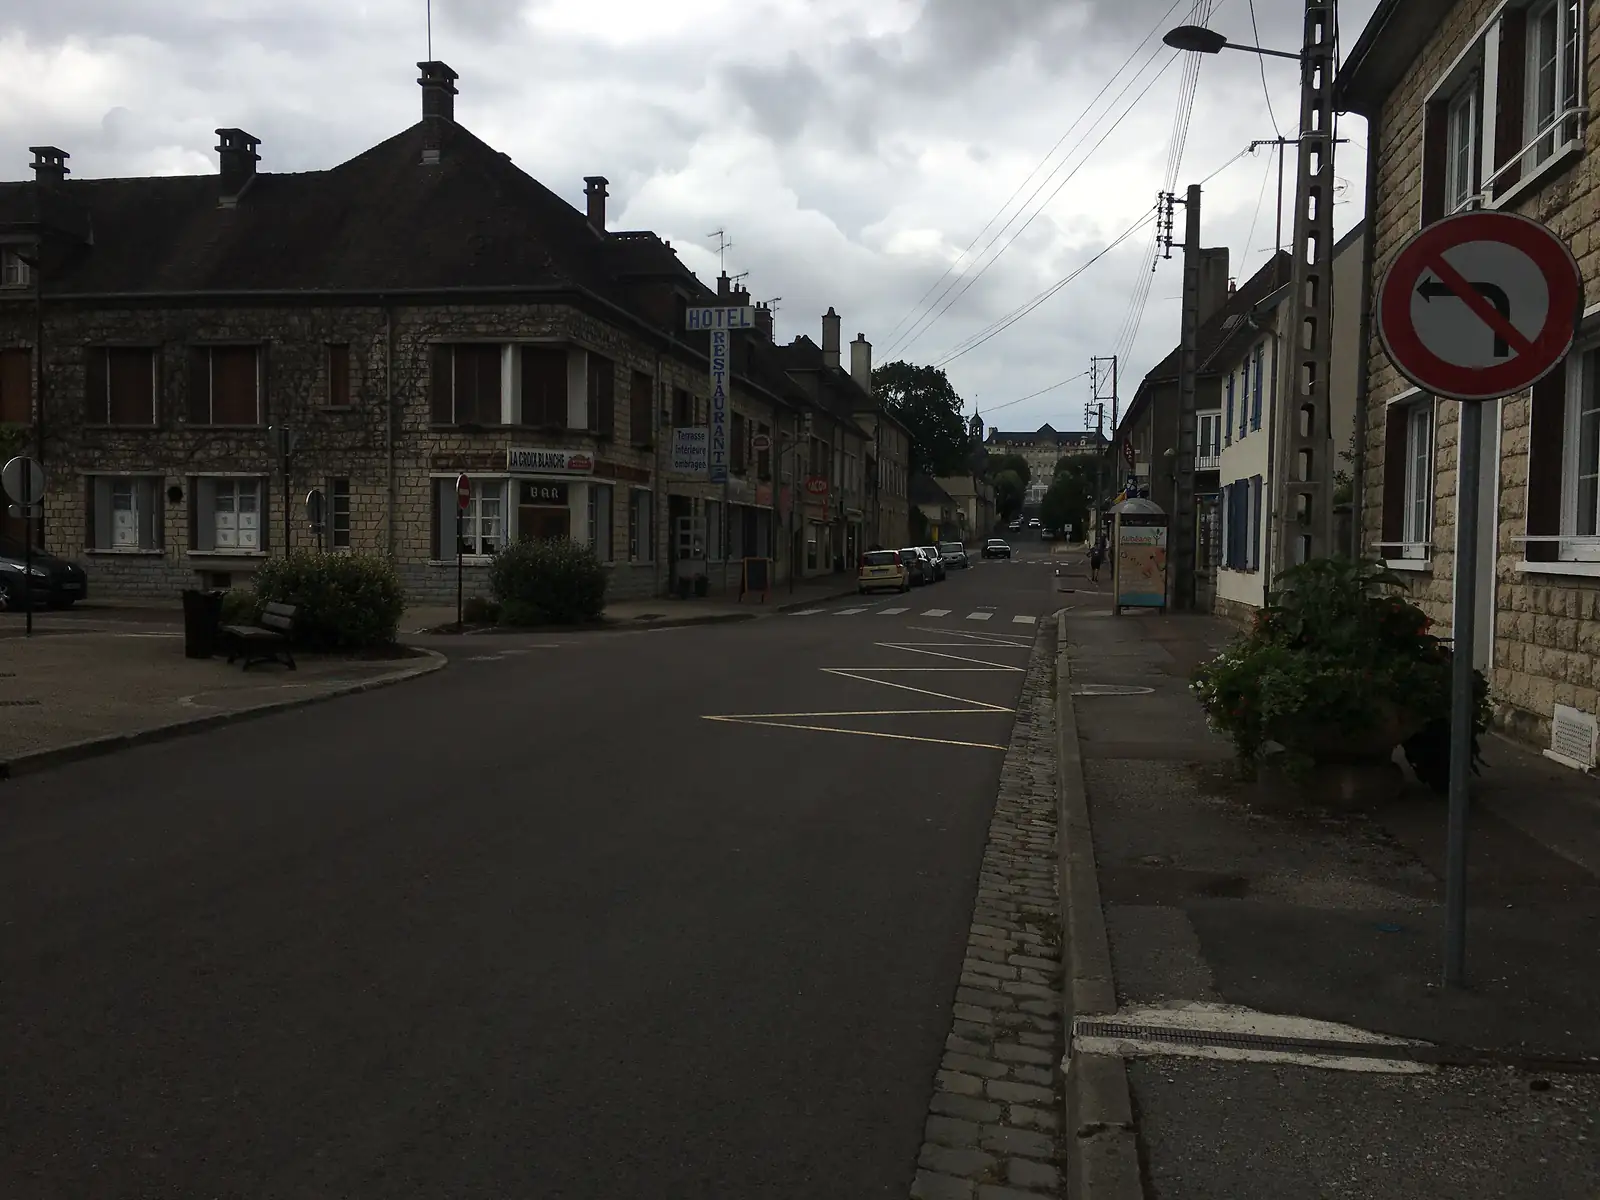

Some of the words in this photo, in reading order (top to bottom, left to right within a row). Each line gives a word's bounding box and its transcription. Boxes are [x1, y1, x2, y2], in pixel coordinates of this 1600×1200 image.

[689, 308, 750, 328] HOTEL
[713, 331, 725, 463] RESTAURANT
[677, 430, 705, 440] Terrasse
[510, 452, 518, 467] LA
[519, 452, 537, 468] CROIX
[538, 453, 565, 469] BLANCHE
[530, 486, 559, 499] BAR
